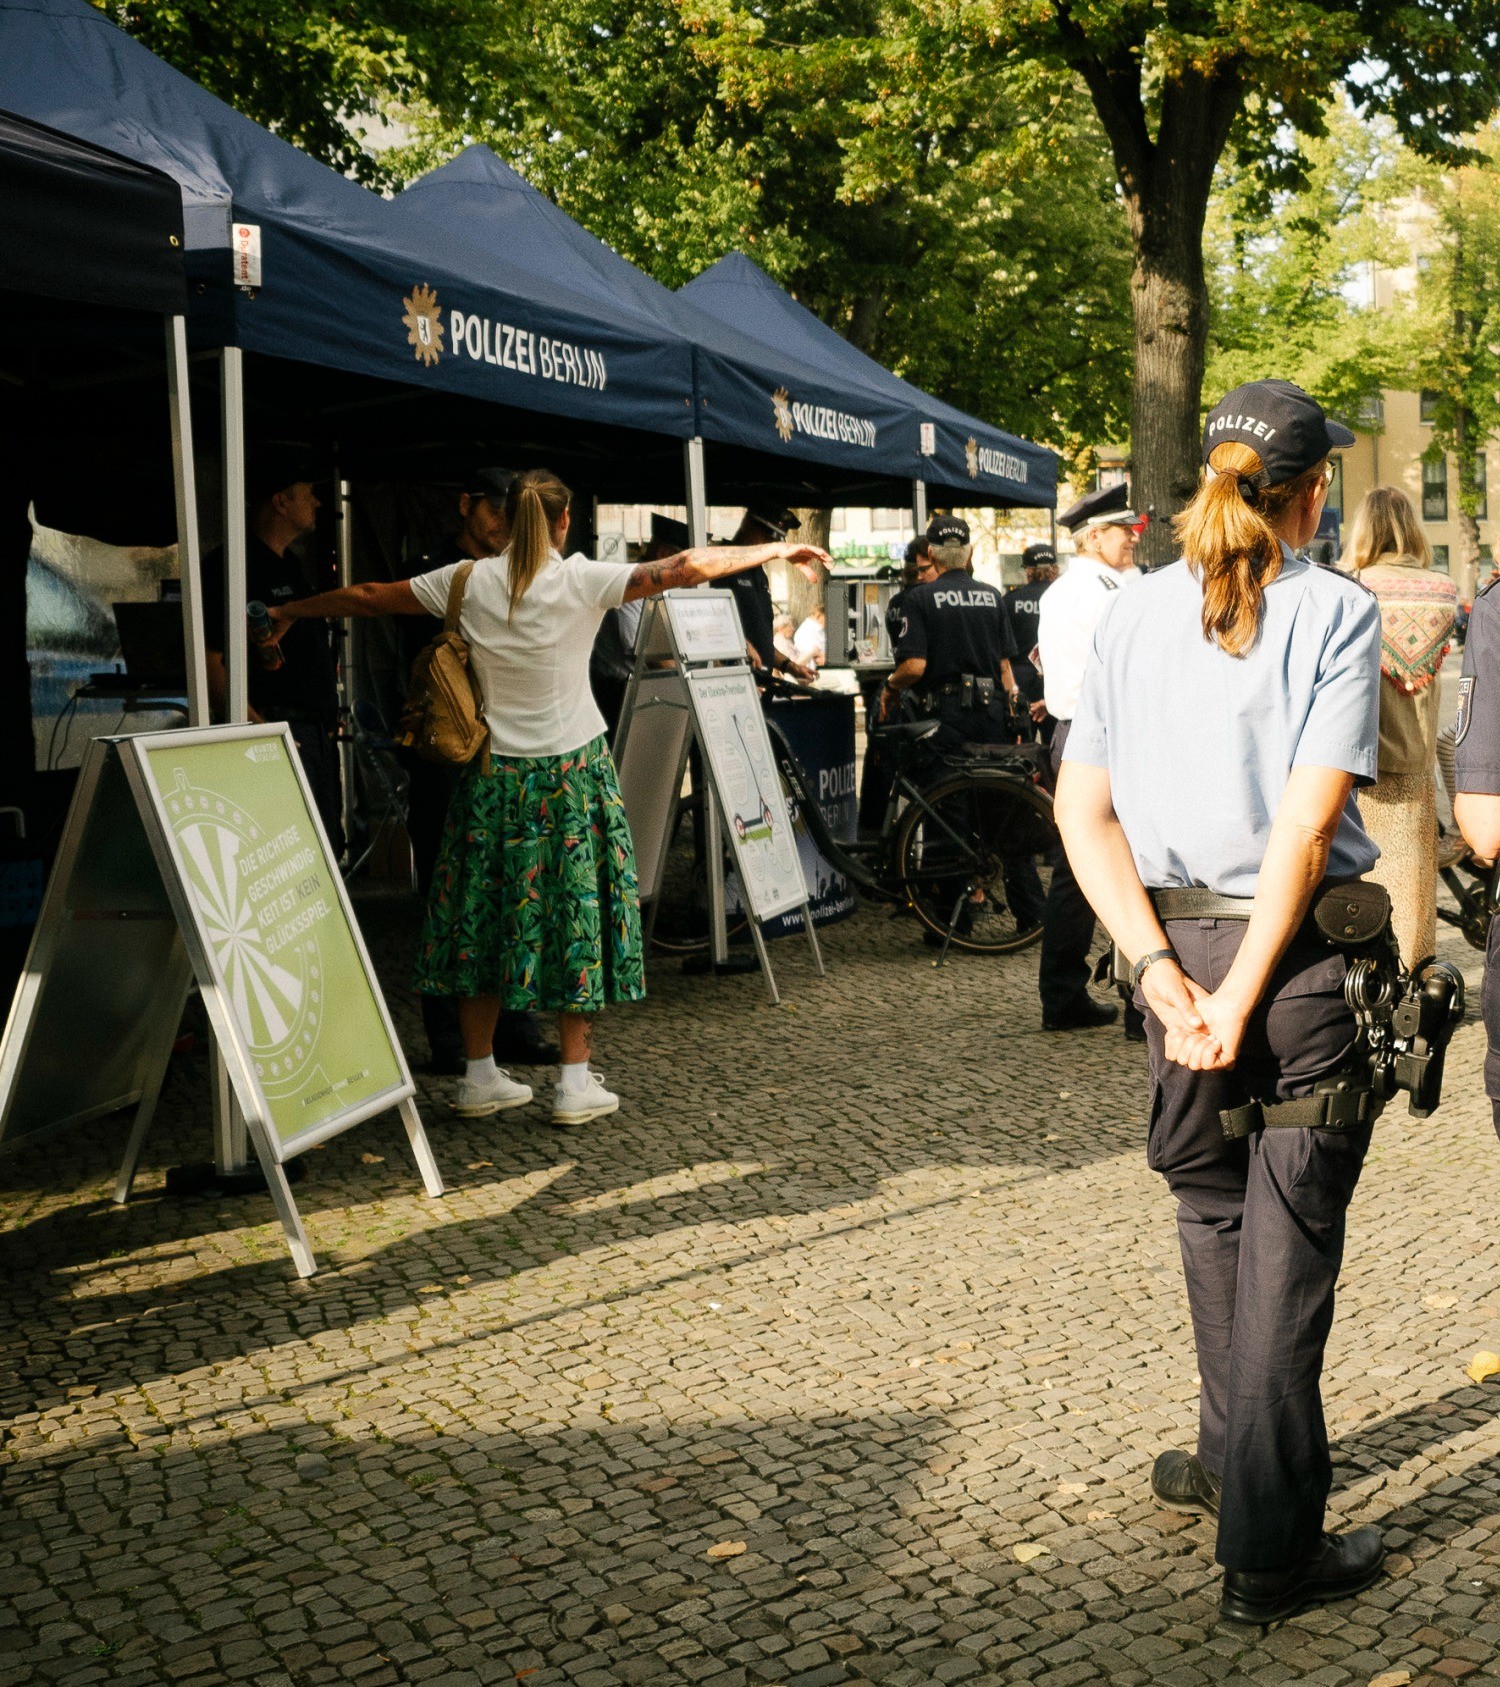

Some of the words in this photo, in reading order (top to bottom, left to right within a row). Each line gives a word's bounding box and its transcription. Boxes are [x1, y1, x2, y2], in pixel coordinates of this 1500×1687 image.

[451, 309, 536, 375] POLIZEI
[539, 336, 607, 391] BERLIN
[792, 402, 838, 440] POLIZEI
[837, 413, 877, 448] BERLIN
[1209, 414, 1276, 441] POLIZEI
[978, 447, 1006, 477] POLIZEI
[1005, 454, 1028, 483] BERLIN
[938, 526, 966, 537] POLIZEI
[1033, 551, 1054, 561] POLIZEI
[933, 590, 997, 608] POLIZEI
[238, 853, 258, 877] DIE
[257, 825, 300, 866] RICHTIGE
[247, 847, 316, 902] GESCHWINDIG-
[257, 903, 282, 930] KEIT
[279, 888, 298, 912] IST
[295, 872, 321, 898] KEIN
[265, 898, 331, 954] GLÜCKSSPIEL
